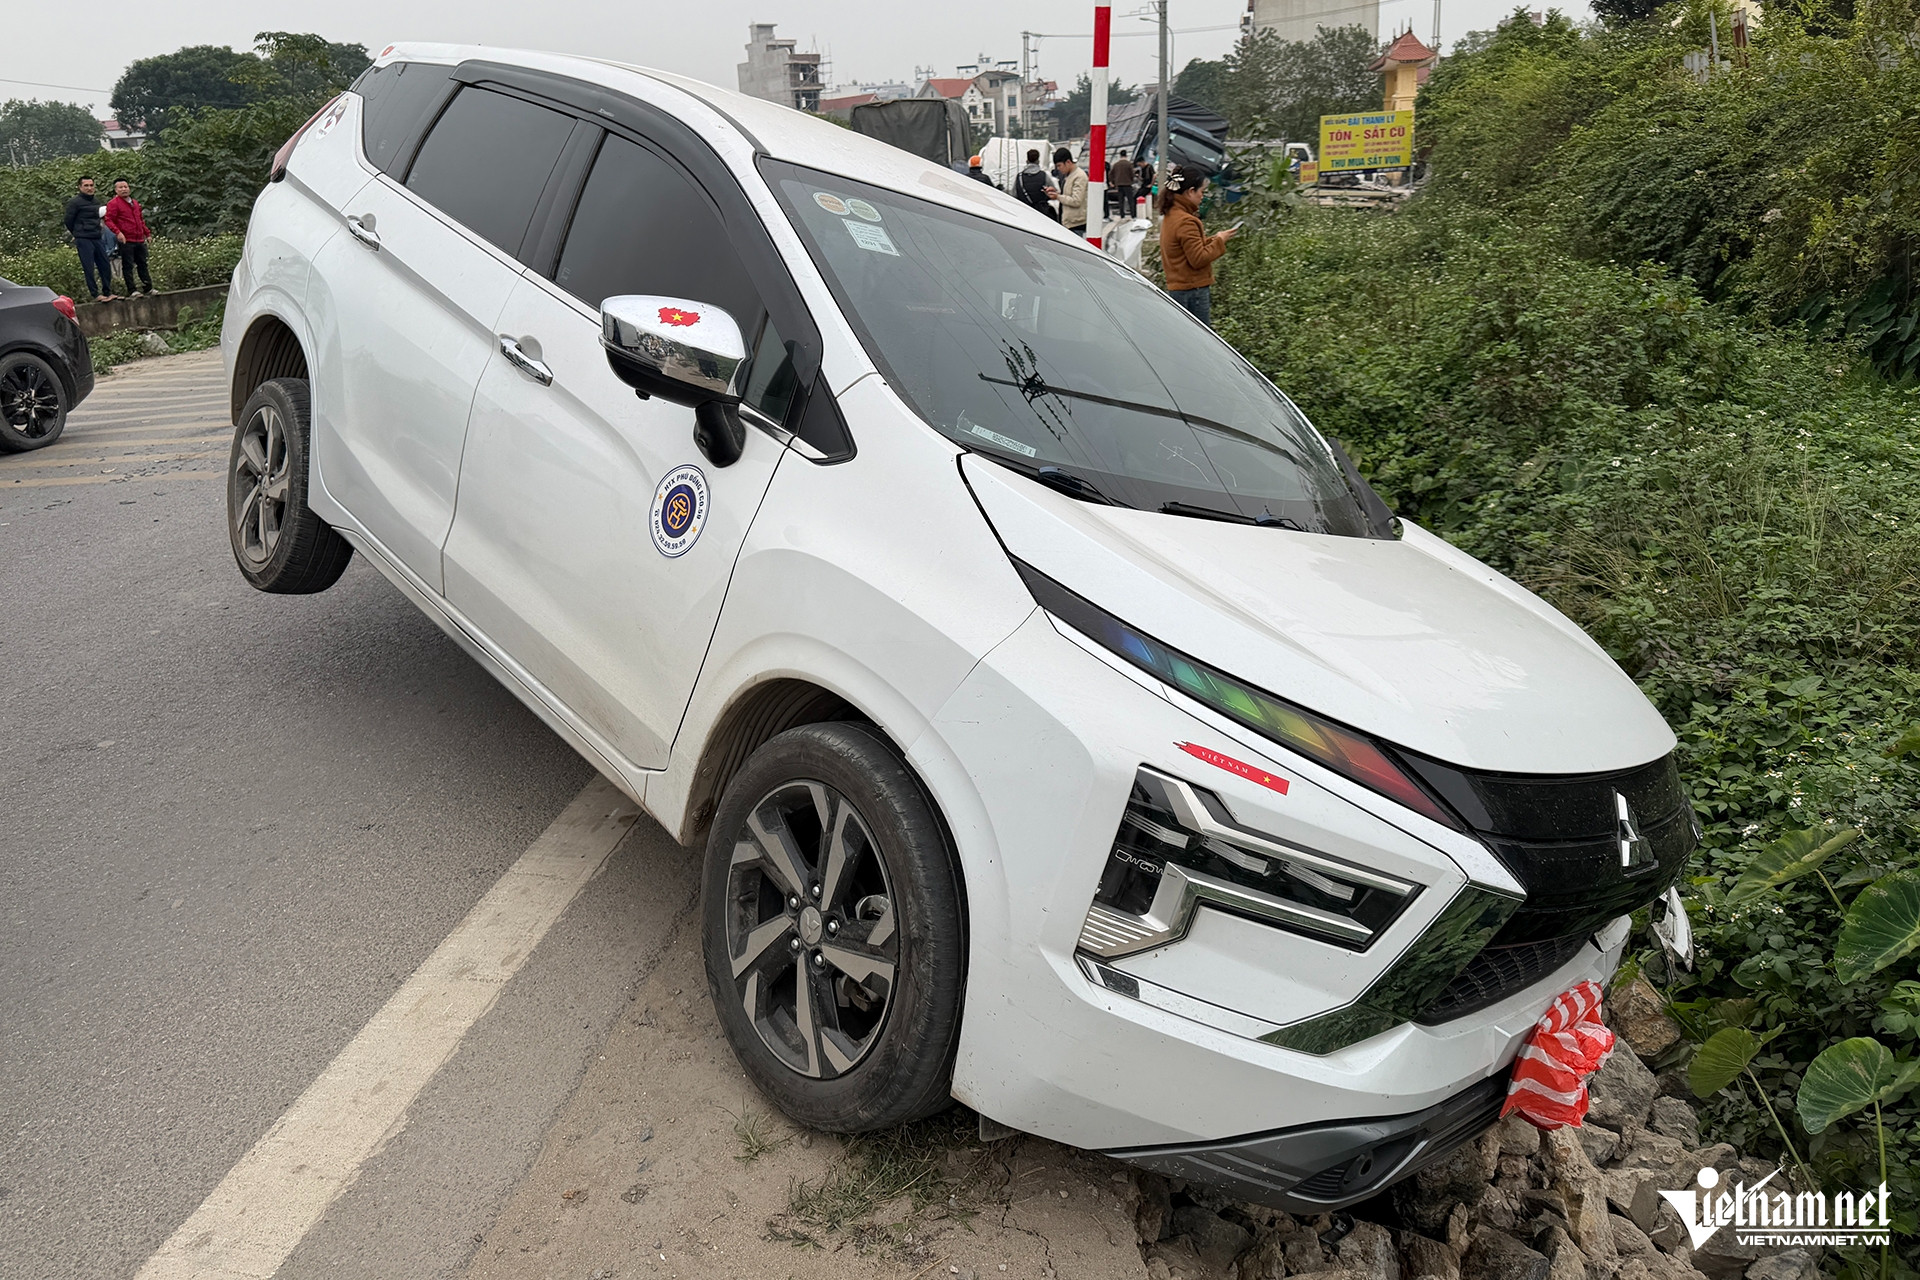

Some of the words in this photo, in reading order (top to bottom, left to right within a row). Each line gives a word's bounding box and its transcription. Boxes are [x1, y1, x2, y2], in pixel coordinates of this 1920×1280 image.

[1362, 116, 1385, 125] THANH
[1329, 129, 1351, 141] TÔN
[1363, 125, 1386, 139] SẮT
[1331, 159, 1346, 168] THU
[1348, 158, 1365, 167] MUA
[1367, 154, 1383, 166] SẮT
[664, 478, 676, 491] HTX
[1201, 752, 1224, 764] VIỆT
[1228, 762, 1248, 774] NAM
